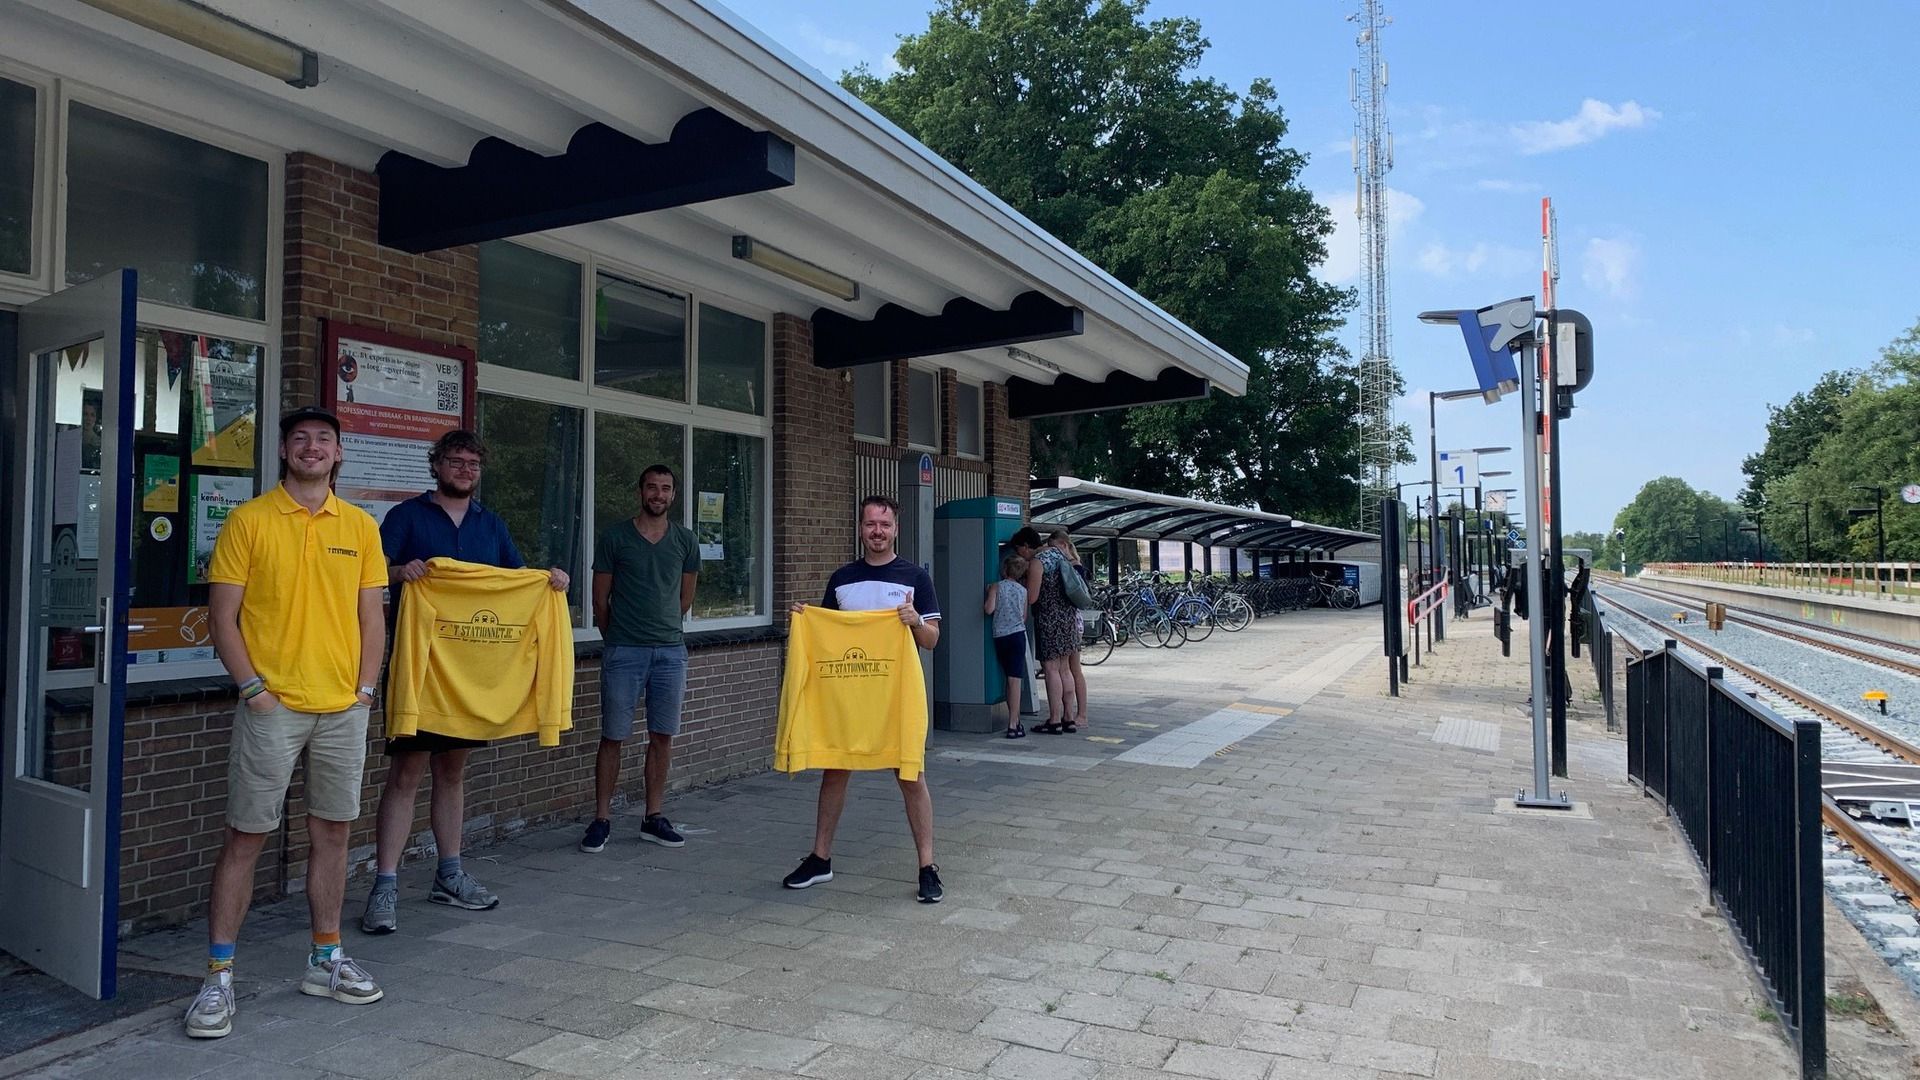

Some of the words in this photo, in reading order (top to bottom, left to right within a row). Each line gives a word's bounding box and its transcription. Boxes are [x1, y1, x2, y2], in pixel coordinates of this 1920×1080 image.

[435, 363, 452, 375] VEB
[1455, 466, 1464, 484] 1
[201, 493, 224, 502] kennis
[461, 624, 514, 639] STATIONNETJE
[835, 662, 881, 674] STATIONNETJE
